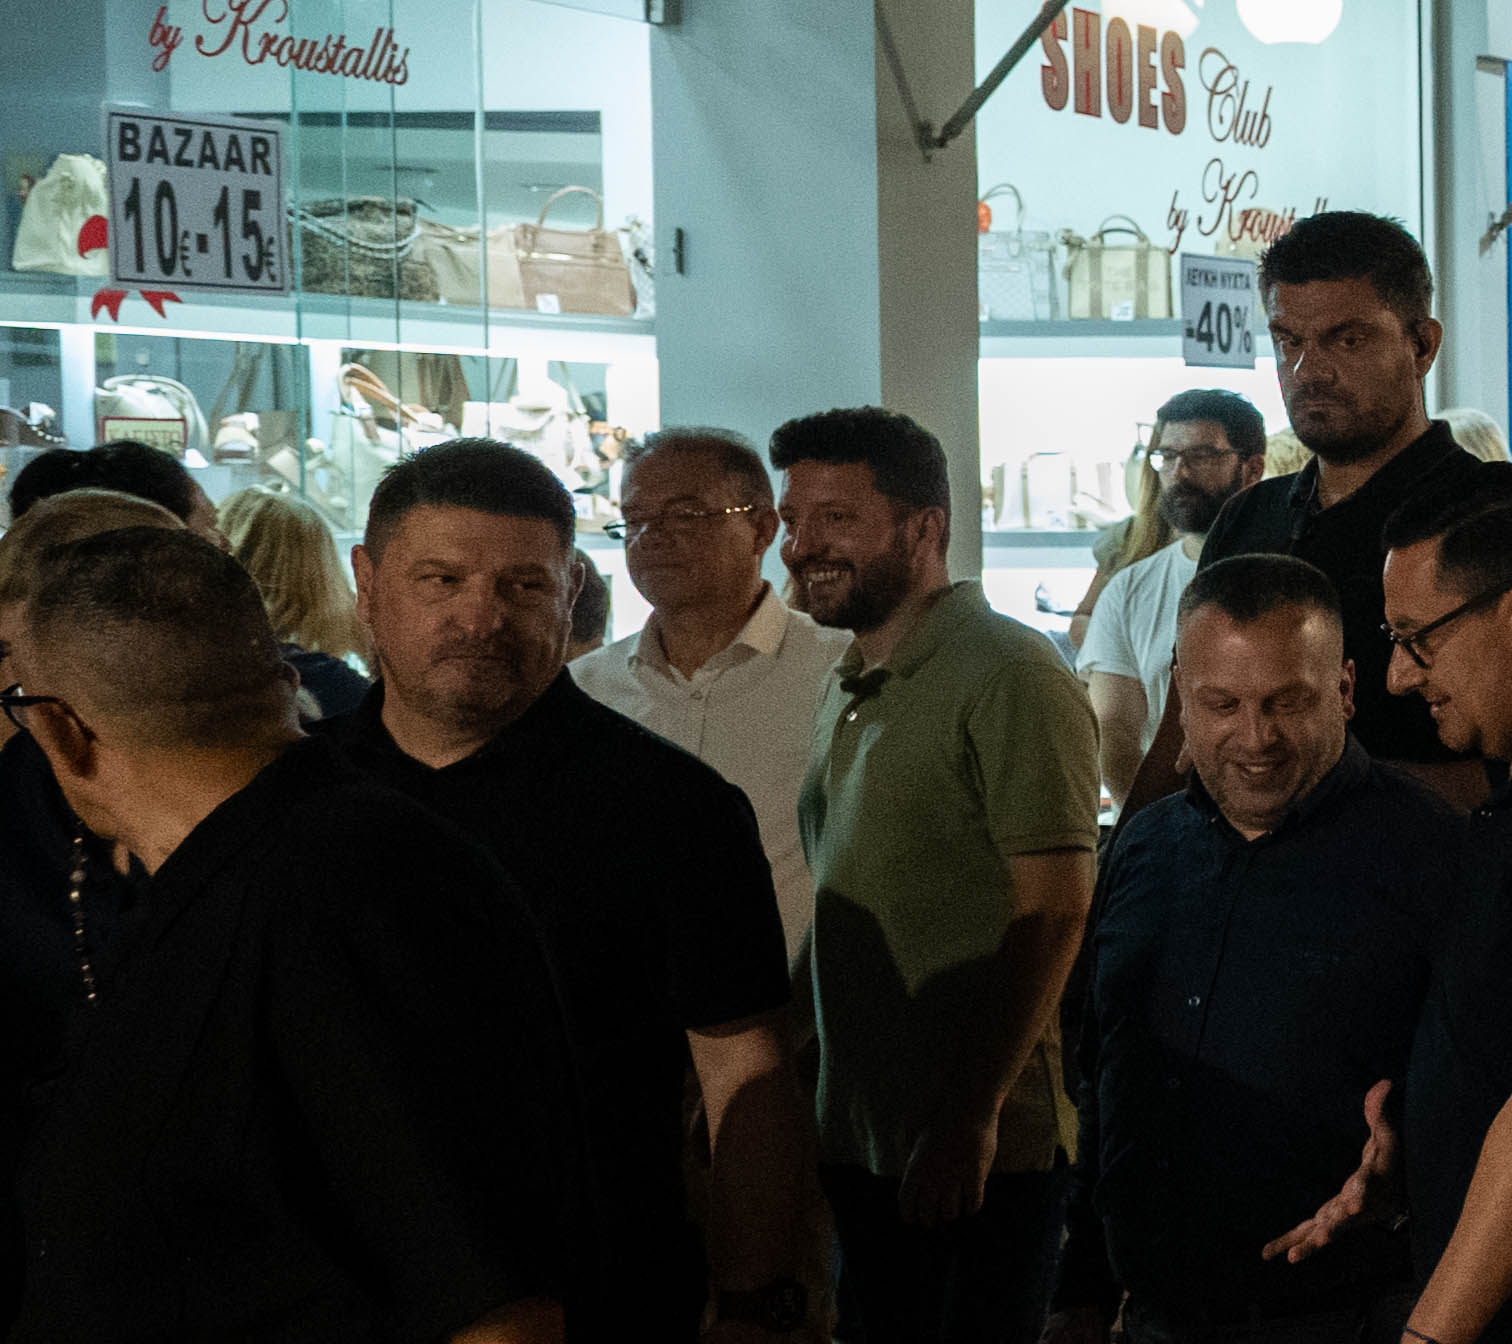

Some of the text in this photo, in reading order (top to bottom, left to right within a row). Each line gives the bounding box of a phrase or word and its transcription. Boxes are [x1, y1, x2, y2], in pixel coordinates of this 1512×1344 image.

[148, 5, 184, 73] by
[1040, 0, 1273, 149] SHOES Club
[118, 121, 273, 177] BAZAAR
[1166, 189, 1190, 256] by
